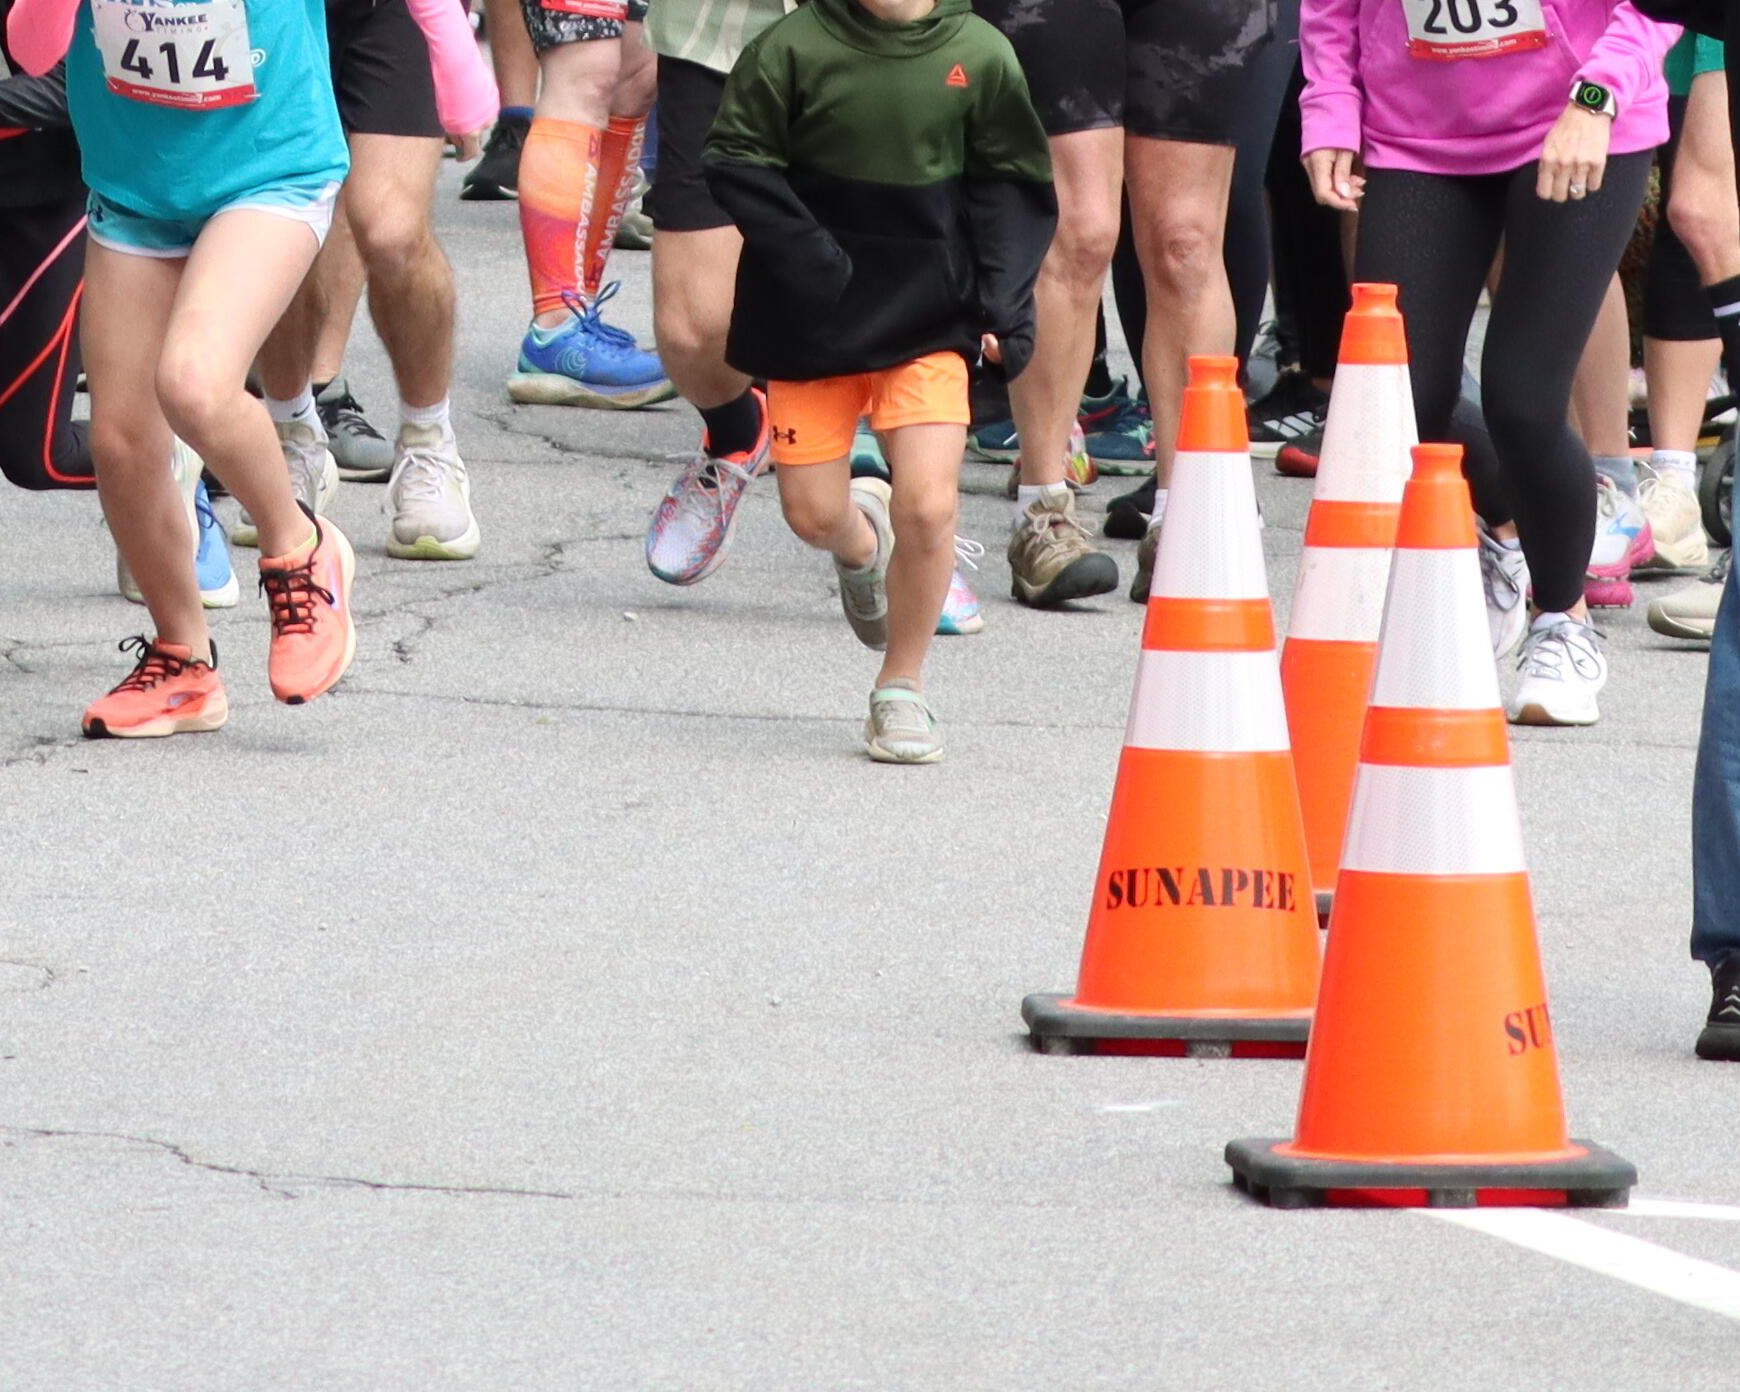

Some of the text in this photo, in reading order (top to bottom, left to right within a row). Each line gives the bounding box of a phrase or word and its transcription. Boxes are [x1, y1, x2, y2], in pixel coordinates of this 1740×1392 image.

[141, 10, 208, 32] YANKEE
[120, 37, 230, 84] 414
[1105, 866, 1297, 912] SUNAPEE
